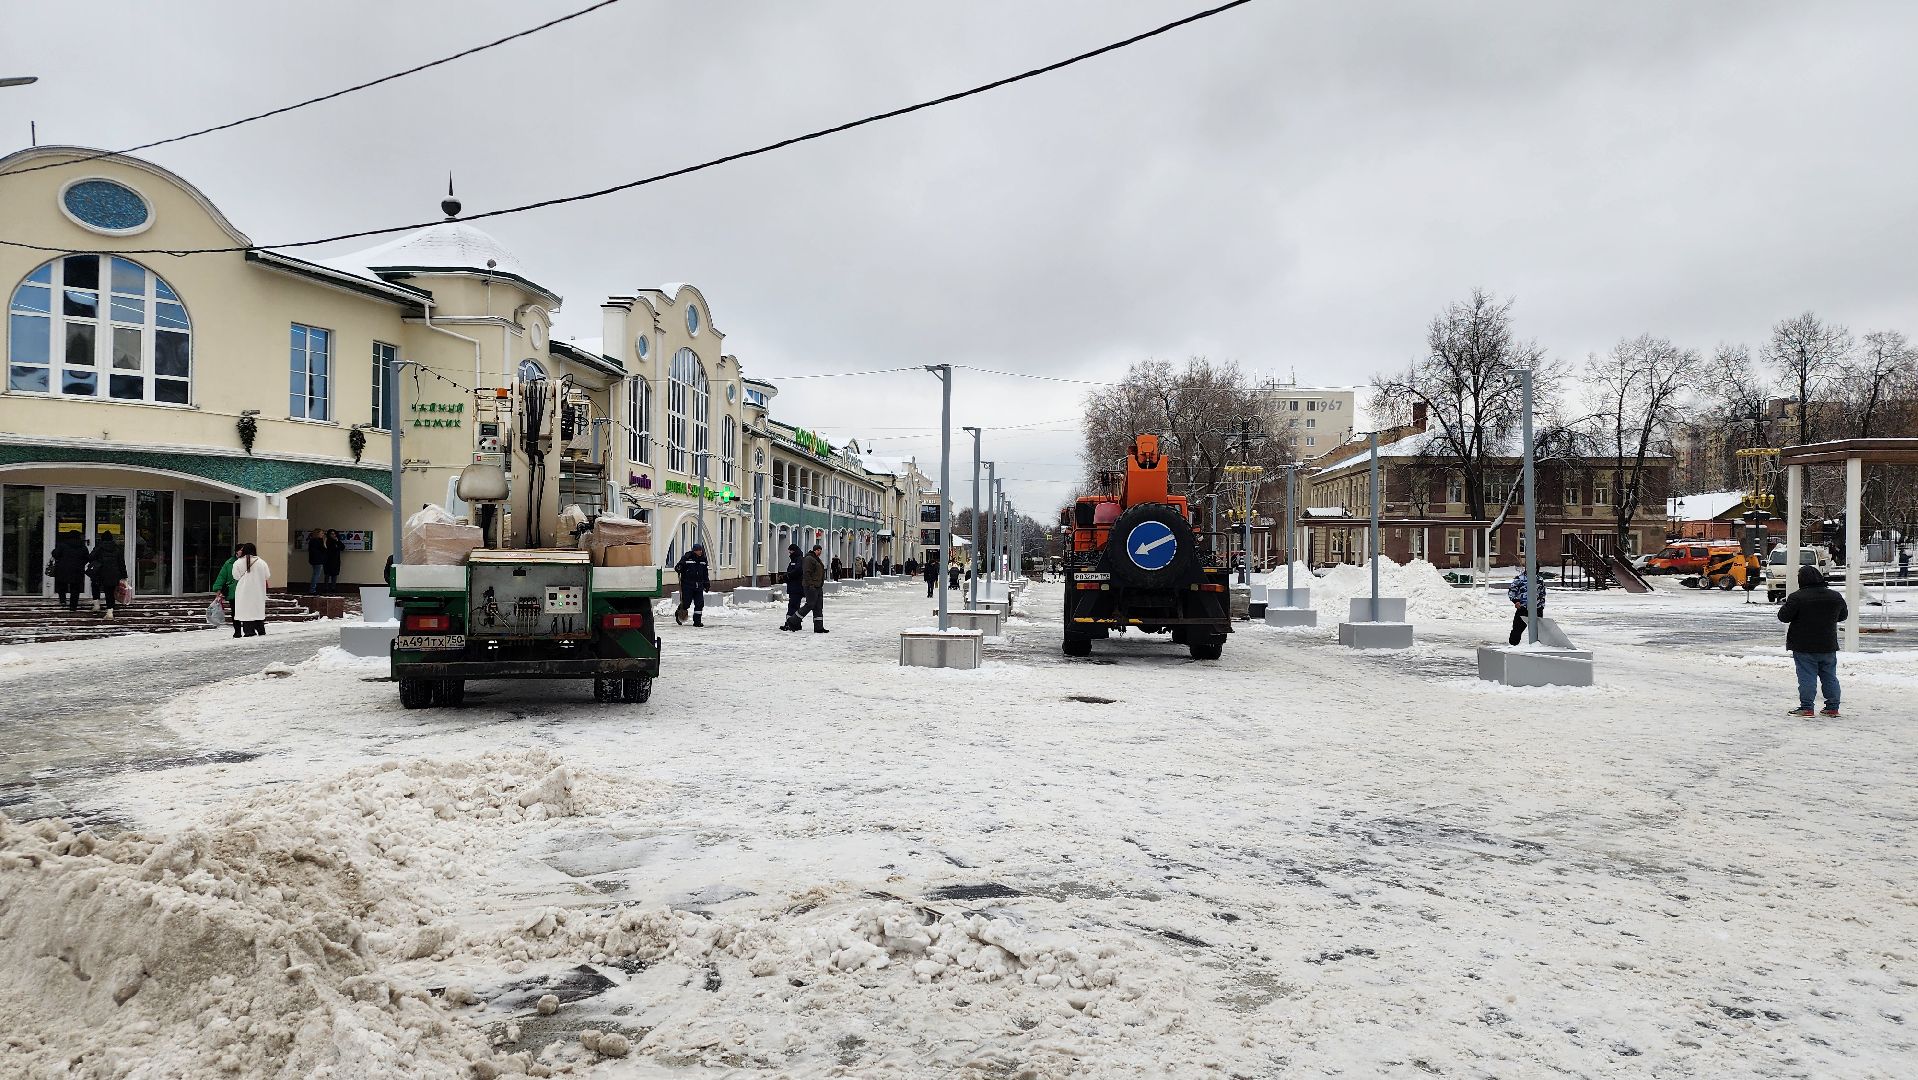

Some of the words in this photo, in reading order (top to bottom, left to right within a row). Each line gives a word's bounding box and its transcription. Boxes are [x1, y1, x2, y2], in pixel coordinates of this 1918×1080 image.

[411, 403, 464, 413] ЧАЙНЫЙ
[1316, 400, 1342, 412] 1967
[414, 419, 461, 428] ДОМИК
[402, 637, 445, 647] А491ТХ
[446, 636, 463, 644] 750
